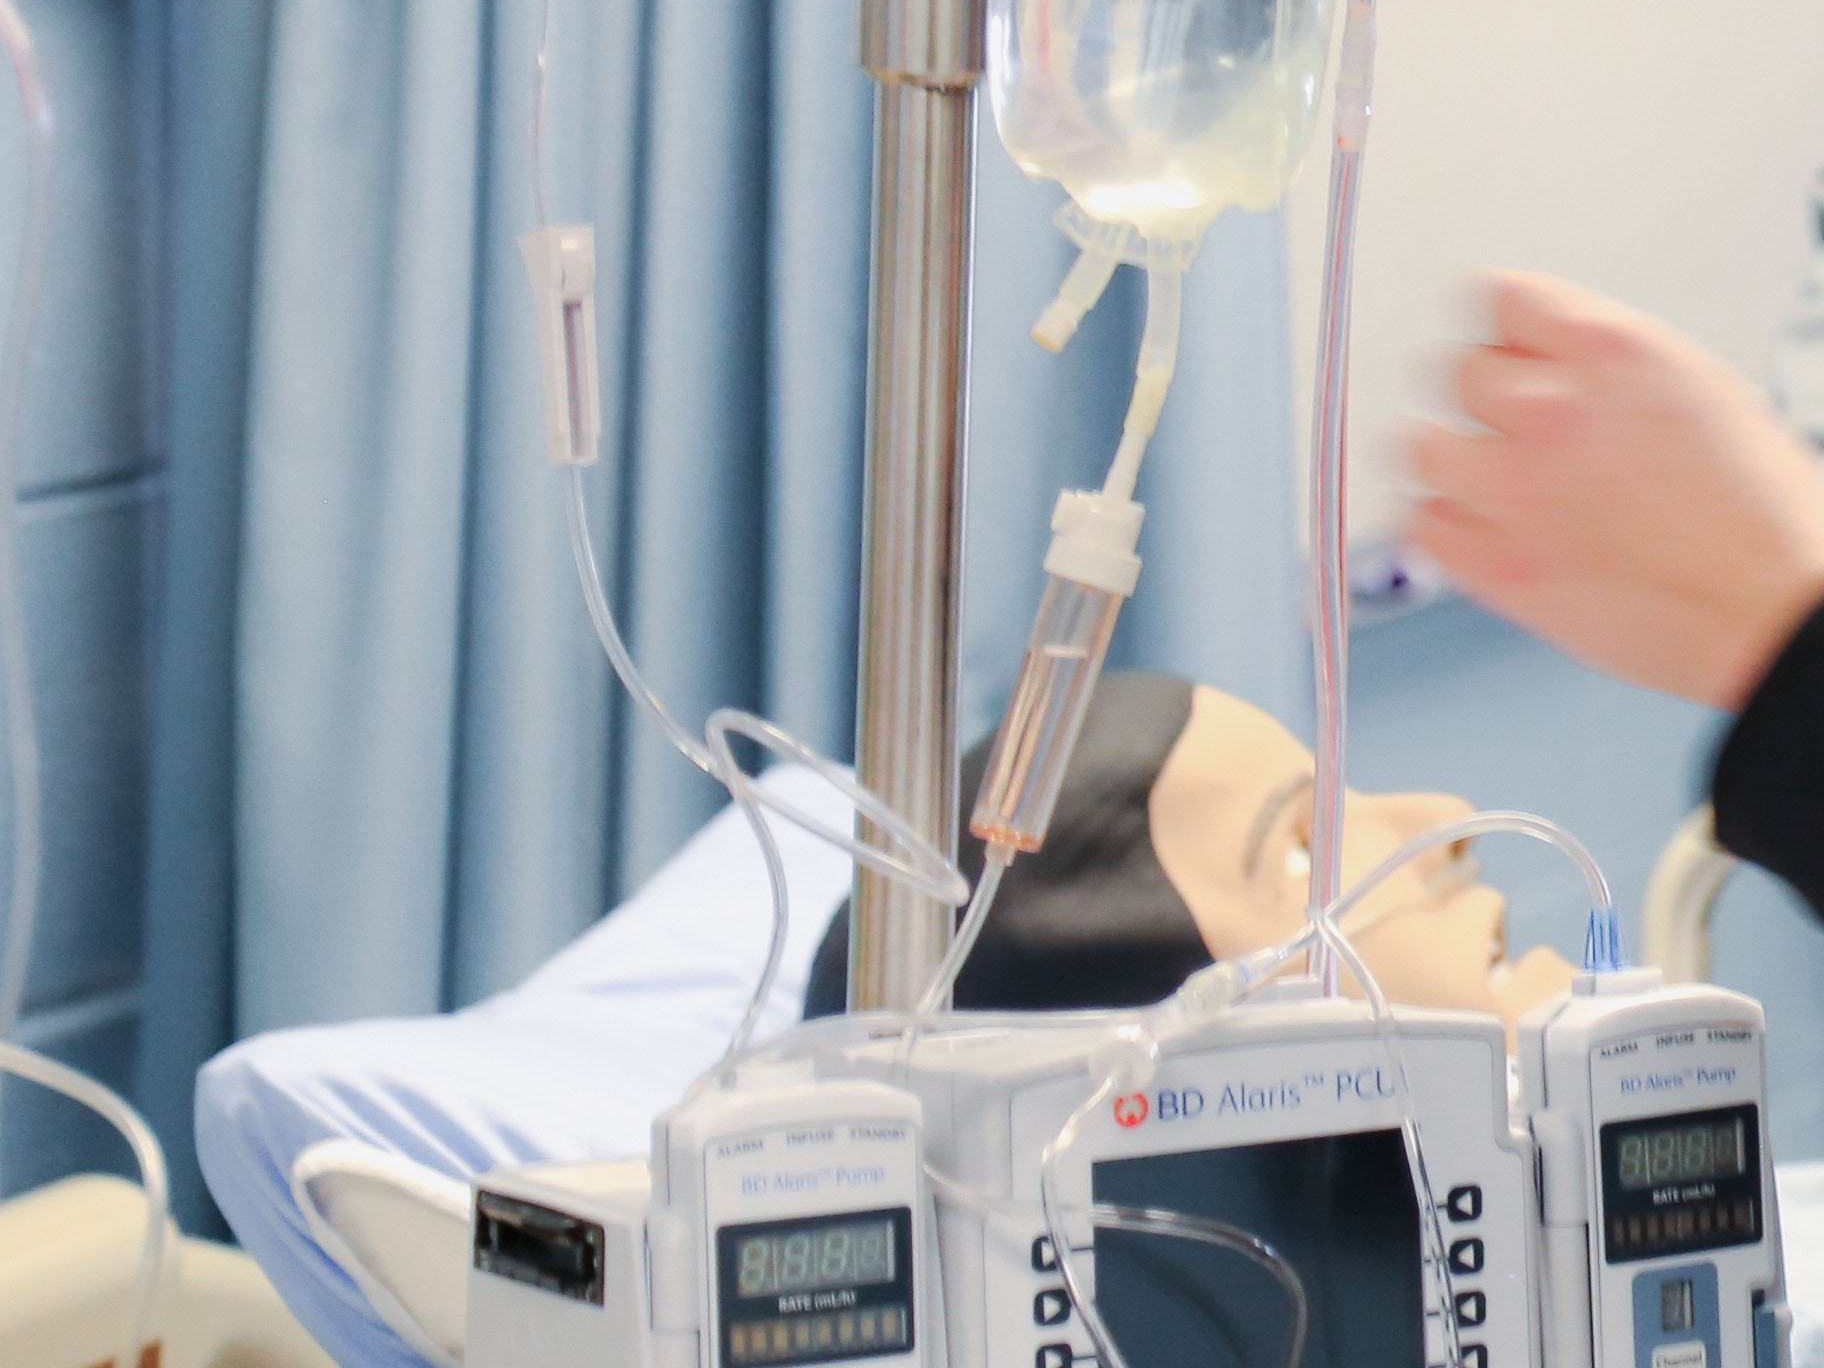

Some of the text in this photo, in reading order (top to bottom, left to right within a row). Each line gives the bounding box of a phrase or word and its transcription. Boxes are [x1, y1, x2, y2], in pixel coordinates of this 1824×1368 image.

[1620, 1077, 1642, 1094] BD
[1696, 1065, 1737, 1087] Pump
[1156, 1086, 1204, 1121] BD
[740, 1175, 766, 1195] BD
[836, 1166, 886, 1187] Pump
[777, 1295, 811, 1314] RATE
